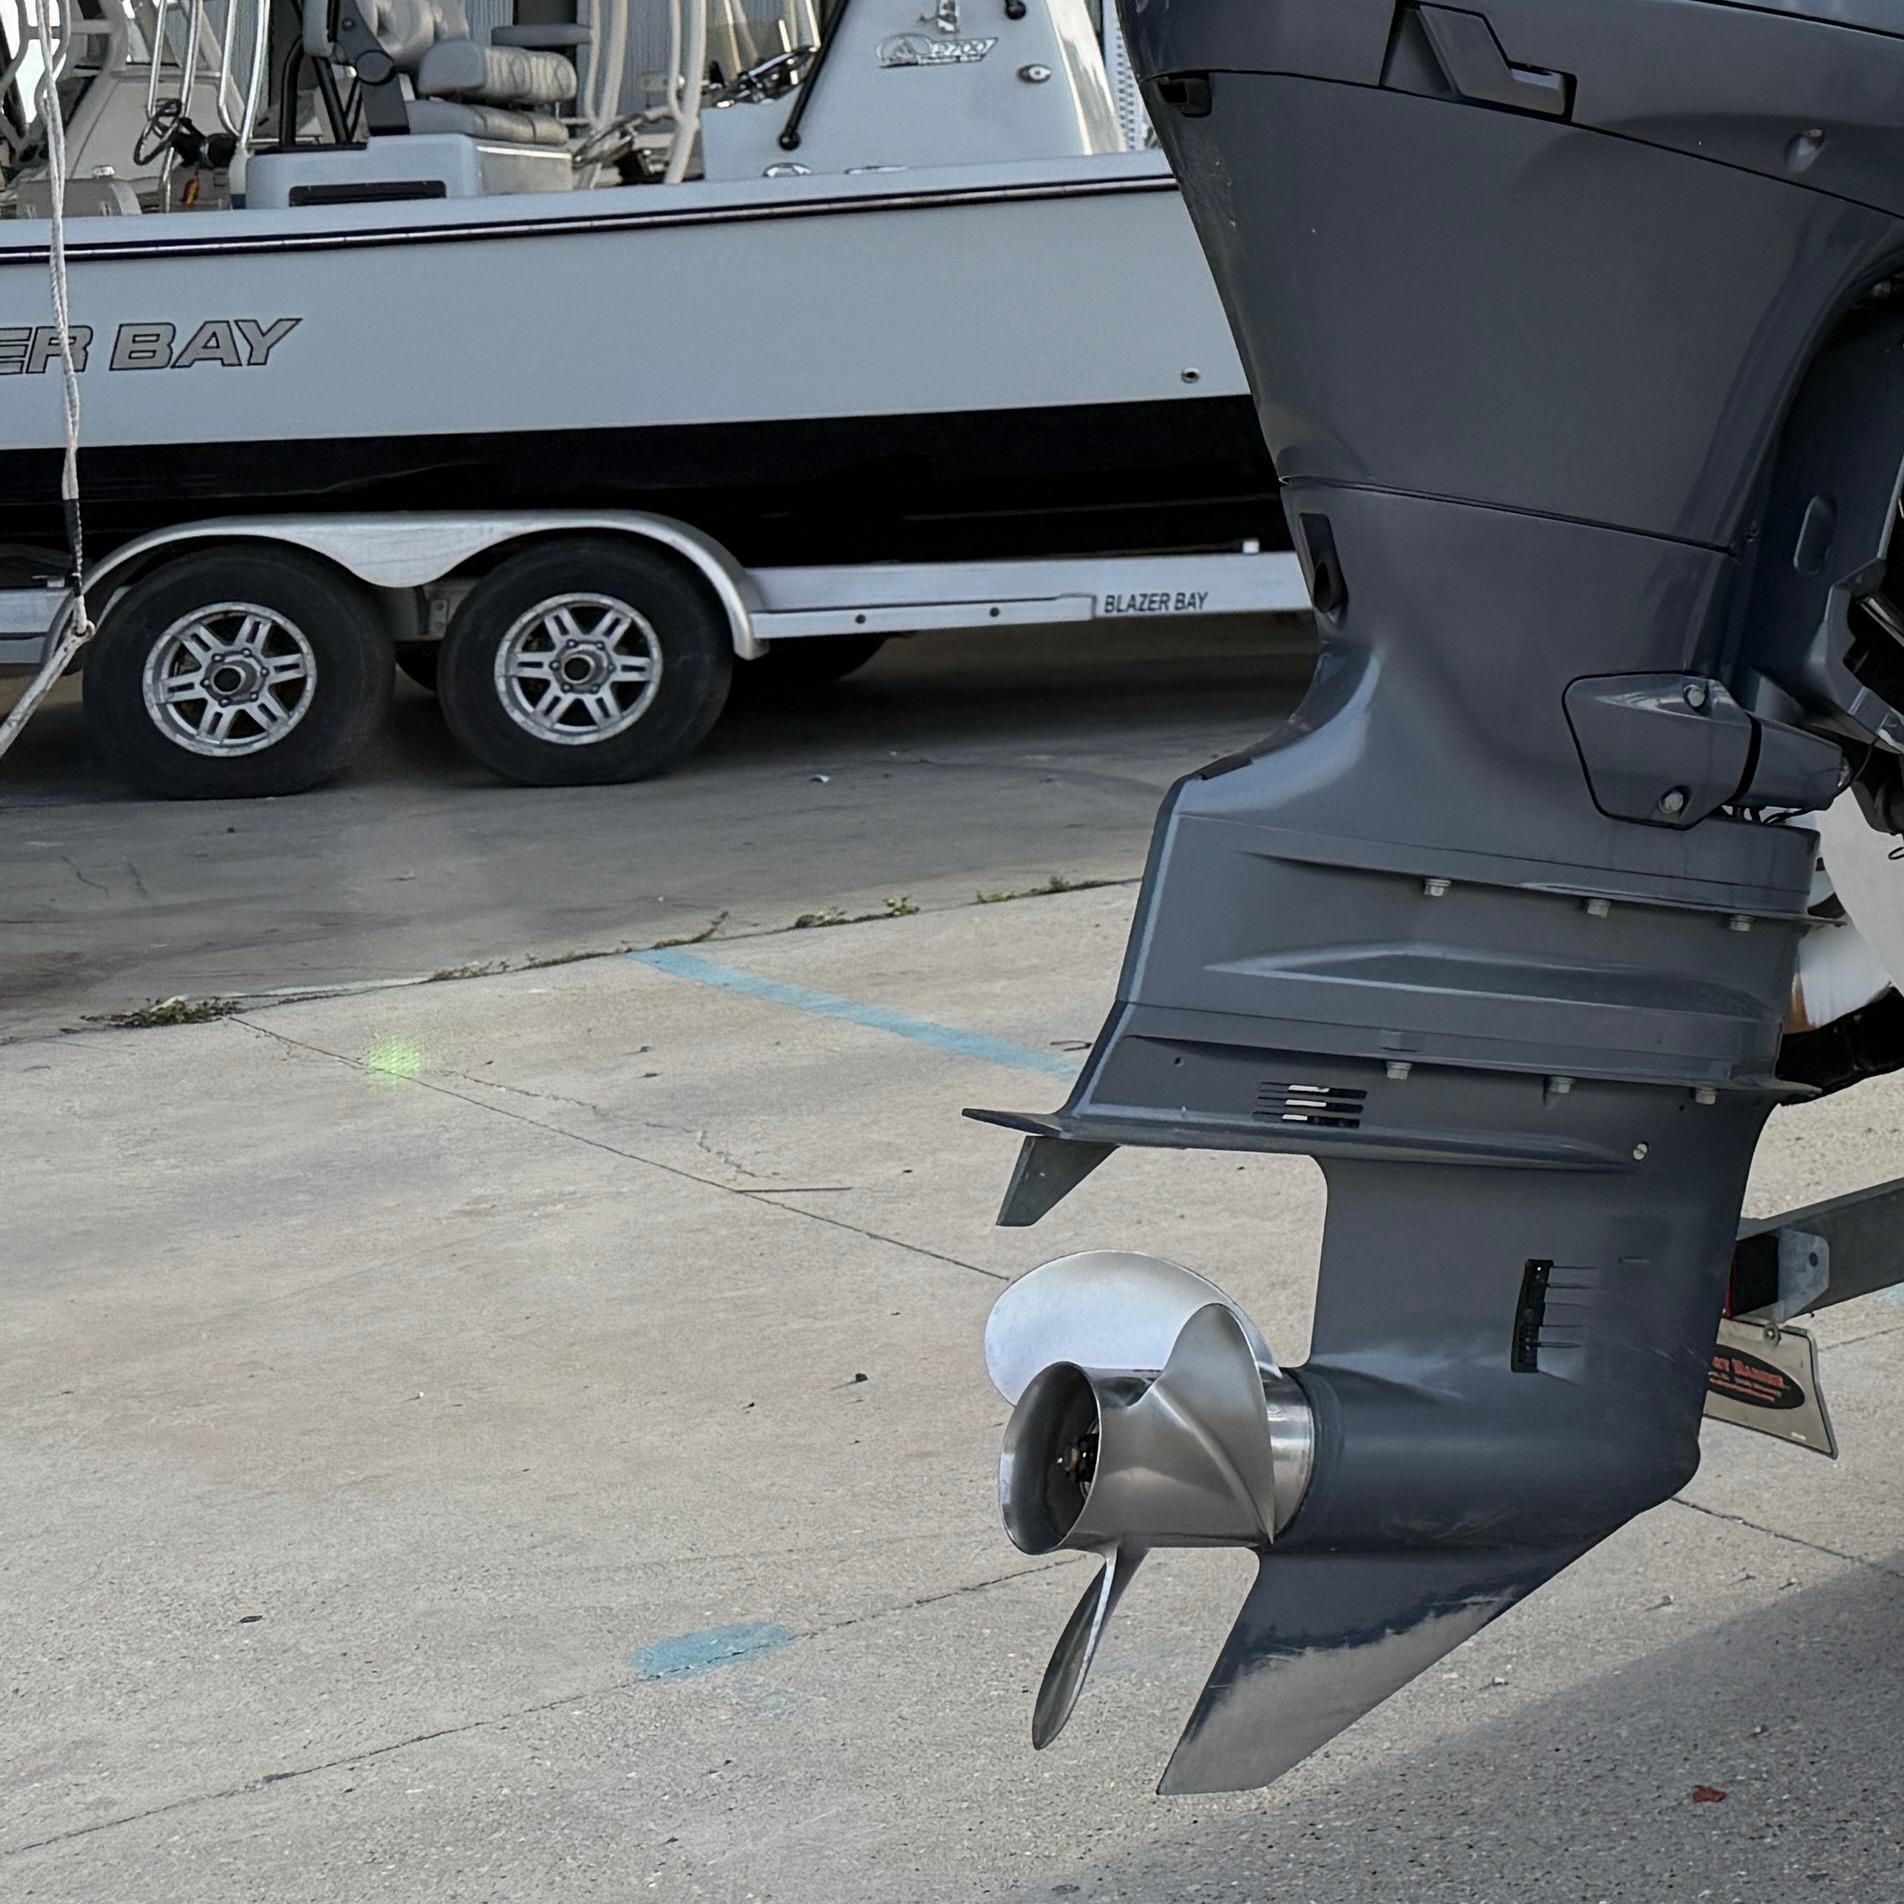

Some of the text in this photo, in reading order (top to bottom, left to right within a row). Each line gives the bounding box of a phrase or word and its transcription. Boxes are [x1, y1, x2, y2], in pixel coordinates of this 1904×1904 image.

[109, 318, 303, 371] BAY
[1104, 592, 1208, 613] BLAZER BAY
